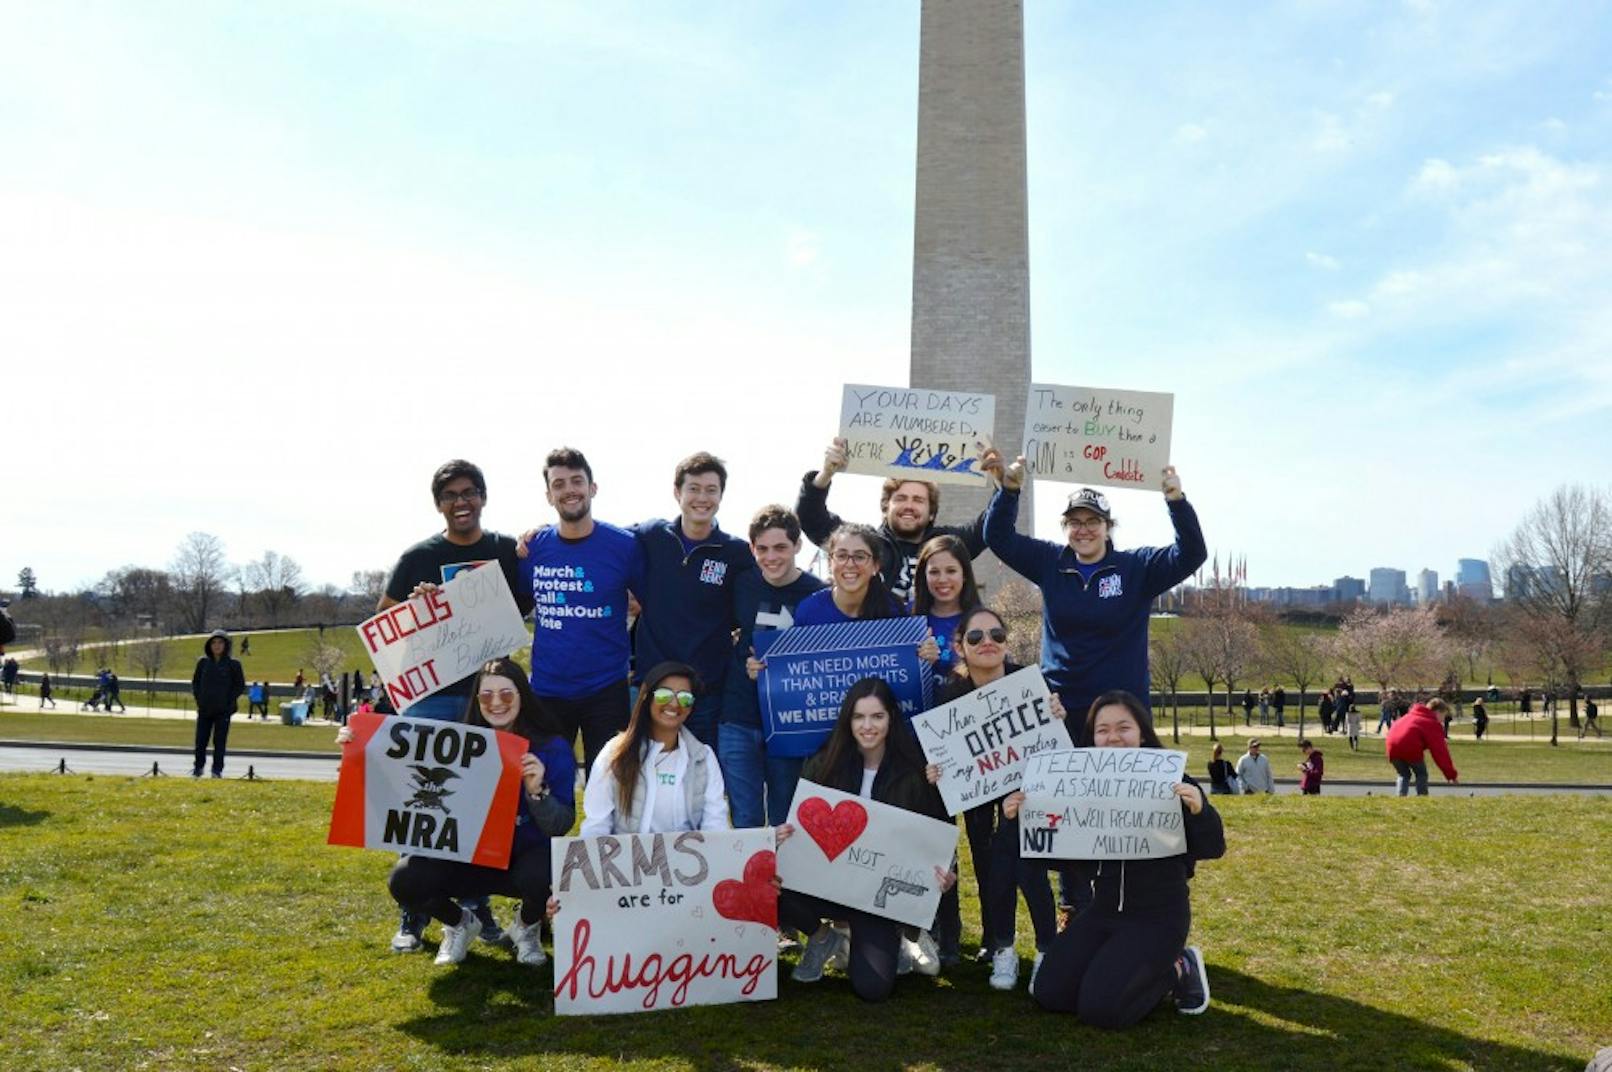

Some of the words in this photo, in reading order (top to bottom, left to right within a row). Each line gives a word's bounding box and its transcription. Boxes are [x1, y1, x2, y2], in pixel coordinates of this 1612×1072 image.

[853, 389, 919, 410] YOUR
[927, 393, 983, 414] DAYS
[1034, 389, 1063, 410] The
[1108, 400, 1144, 424] thing
[849, 412, 883, 428] ARE
[1084, 421, 1116, 436] BUY
[1149, 434, 1157, 444] a
[1025, 438, 1056, 475] GUN
[1083, 444, 1107, 461] GOP
[1065, 462, 1073, 472] a
[362, 588, 453, 653] FOCUS
[787, 660, 811, 675] WE
[813, 657, 853, 673] NEED
[857, 653, 899, 669] MORE
[387, 659, 440, 709] NOT
[781, 675, 824, 692] THAN
[805, 693, 817, 707] &
[778, 710, 804, 724] WE
[806, 708, 841, 723] NEE
[921, 707, 976, 740] When
[1021, 687, 1034, 699] in
[964, 697, 1050, 757] OFFICE
[386, 722, 487, 768] STOP
[952, 765, 974, 782] my
[976, 745, 1019, 776] NRA
[1026, 751, 1184, 774] TEENAGERS
[983, 778, 998, 796] be
[1054, 778, 1127, 798] ASSAULT
[1128, 778, 1176, 800] RIFLES
[383, 808, 459, 853] NRA
[1025, 809, 1045, 820] are
[1061, 806, 1071, 827] A
[1110, 809, 1181, 831] REGULATED
[1023, 827, 1058, 853] NOT
[1092, 835, 1150, 854] MILITIA
[559, 831, 709, 892] ARMS
[849, 846, 886, 867] NOT
[618, 893, 651, 909] are
[658, 888, 684, 905] for
[554, 918, 773, 1009] hugging
